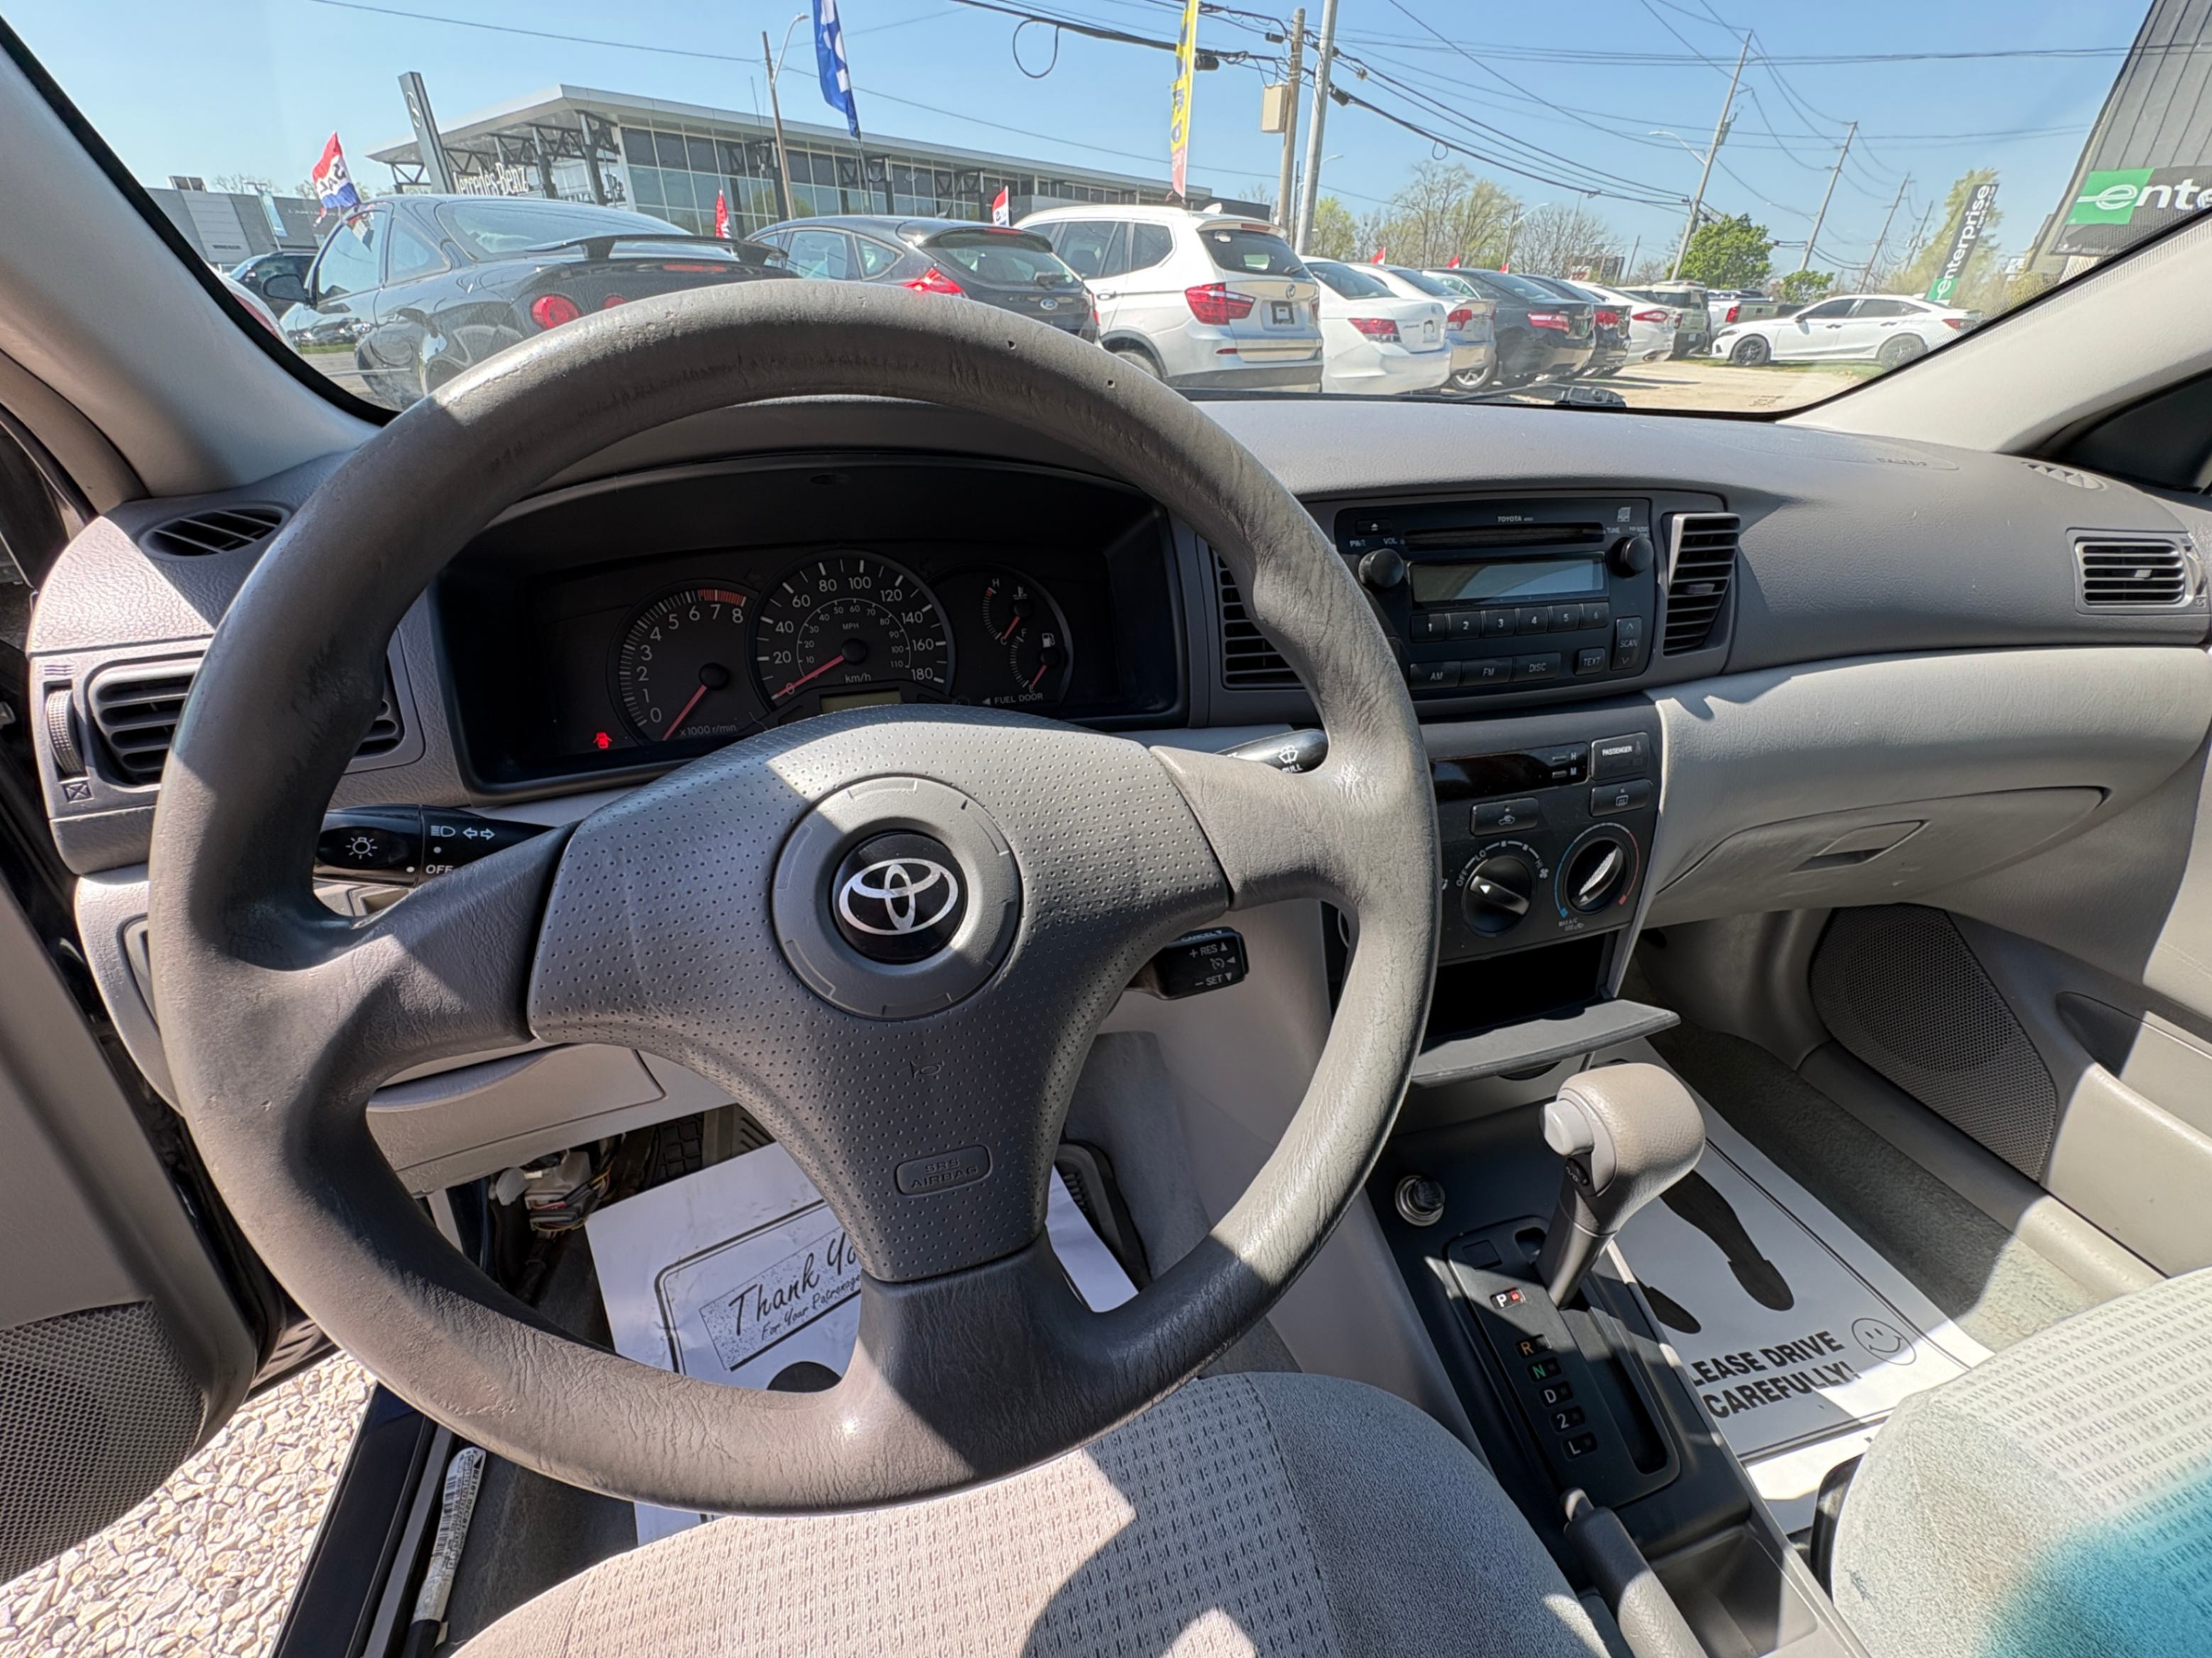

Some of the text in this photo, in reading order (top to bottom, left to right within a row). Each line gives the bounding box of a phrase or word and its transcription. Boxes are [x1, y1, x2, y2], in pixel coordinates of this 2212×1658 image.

[2076, 179, 2212, 211] ente
[1937, 185, 1990, 299] enterprise
[819, 579, 837, 592] 80
[848, 576, 872, 590] 100
[992, 578, 1000, 587] H
[792, 594, 811, 607] 60
[880, 588, 902, 602] 120
[689, 605, 700, 621] 6
[710, 604, 721, 620] 7
[849, 604, 861, 613] 60
[867, 608, 876, 617] 70
[732, 608, 743, 624] 8
[819, 613, 830, 621] 40
[901, 611, 924, 624] 140
[1531, 616, 1537, 624] 4
[1563, 613, 1569, 622] 5
[1593, 611, 1599, 619] 6
[668, 614, 679, 629] 5
[775, 620, 794, 634] 40
[880, 617, 890, 626] 80
[1428, 622, 1432, 632] 1
[1463, 621, 1469, 630] 2
[1498, 619, 1504, 629] 3
[650, 626, 662, 641] 4
[888, 630, 899, 639] 90
[1021, 628, 1027, 637] F
[804, 640, 814, 648] 20
[912, 639, 934, 651] 160
[1620, 639, 1638, 648] SCAN
[641, 645, 653, 661] 3
[773, 651, 792, 664] 20
[1583, 656, 1601, 666] TEXT
[636, 666, 649, 681] 2
[1483, 667, 1495, 677] FM
[1528, 662, 1547, 673] DISC
[845, 673, 871, 683] km/h
[911, 668, 933, 680] 180
[1430, 671, 1444, 680] AM
[642, 688, 650, 703] 1
[995, 692, 1044, 704] FUEL DOOR
[650, 707, 662, 722] 0
[712, 724, 736, 735] r/min
[1571, 752, 1577, 761] H
[1602, 745, 1632, 756] PASSENGER
[1570, 767, 1577, 776] M
[1474, 849, 1486, 861] LO
[426, 865, 453, 875] OFF
[1534, 859, 1544, 869] HI
[1456, 868, 1467, 887] OFF
[1180, 931, 1218, 942] CANCEL
[1200, 944, 1218, 956] RES
[1206, 974, 1222, 985] SET
[924, 1158, 961, 1173] SRS
[911, 1166, 979, 1188] AIRBAG
[729, 1232, 857, 1337] Thank Yo
[1495, 1293, 1507, 1308] P
[761, 1320, 780, 1341] For
[784, 1307, 808, 1326] Your
[1520, 1342, 1534, 1356] R
[1689, 1330, 1845, 1387] LEASE DRIVE
[1532, 1364, 1547, 1379] N
[1544, 1388, 1556, 1403] D
[1703, 1361, 1862, 1418] CAREFULLY!
[1556, 1413, 1569, 1429] 2
[1568, 1441, 1581, 1454] L
